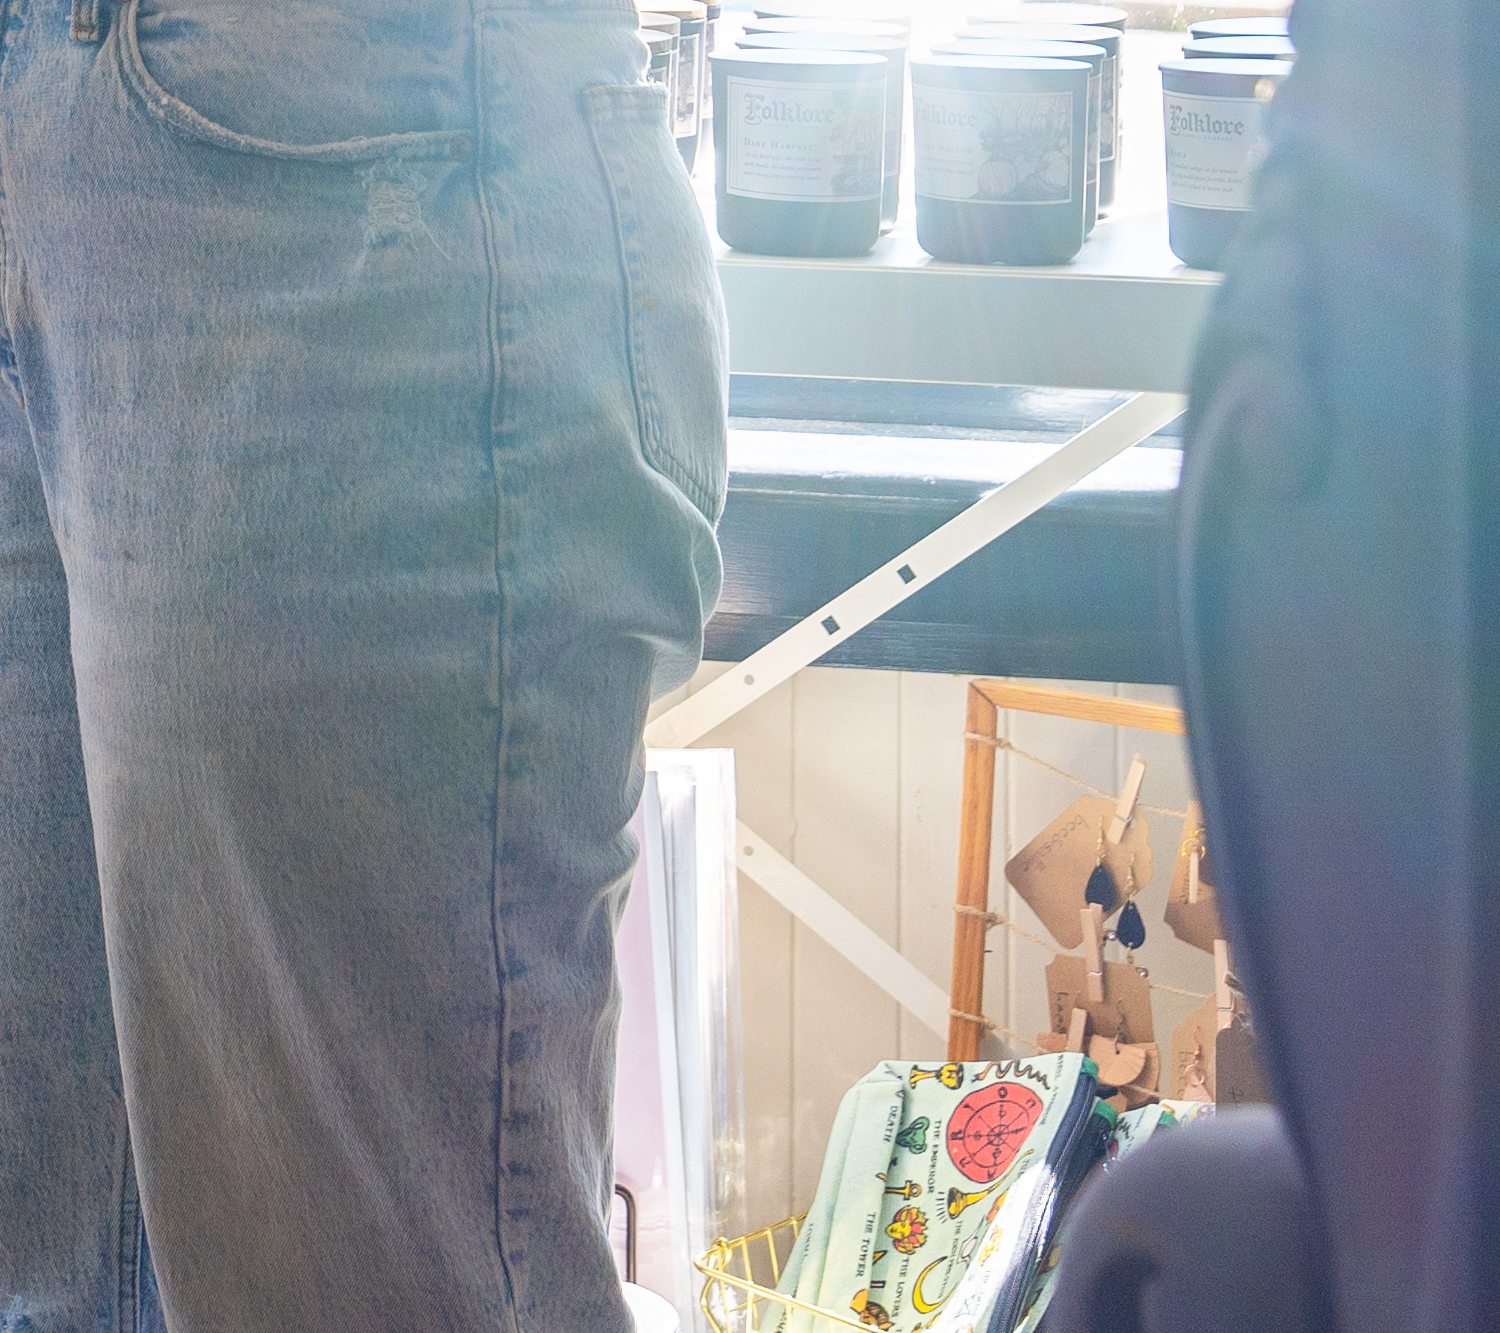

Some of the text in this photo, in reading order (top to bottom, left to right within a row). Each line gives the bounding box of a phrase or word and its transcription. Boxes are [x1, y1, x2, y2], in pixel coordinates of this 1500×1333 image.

[744, 92, 835, 126] Folklore
[1169, 104, 1245, 136] Folklore
[744, 137, 814, 151] DARK HARVEST
[882, 1105, 899, 1144] DEATH
[925, 1118, 942, 1196] THE EMPEROR
[855, 1211, 877, 1279] THE TOWER
[890, 1279, 905, 1319] LOVERS
